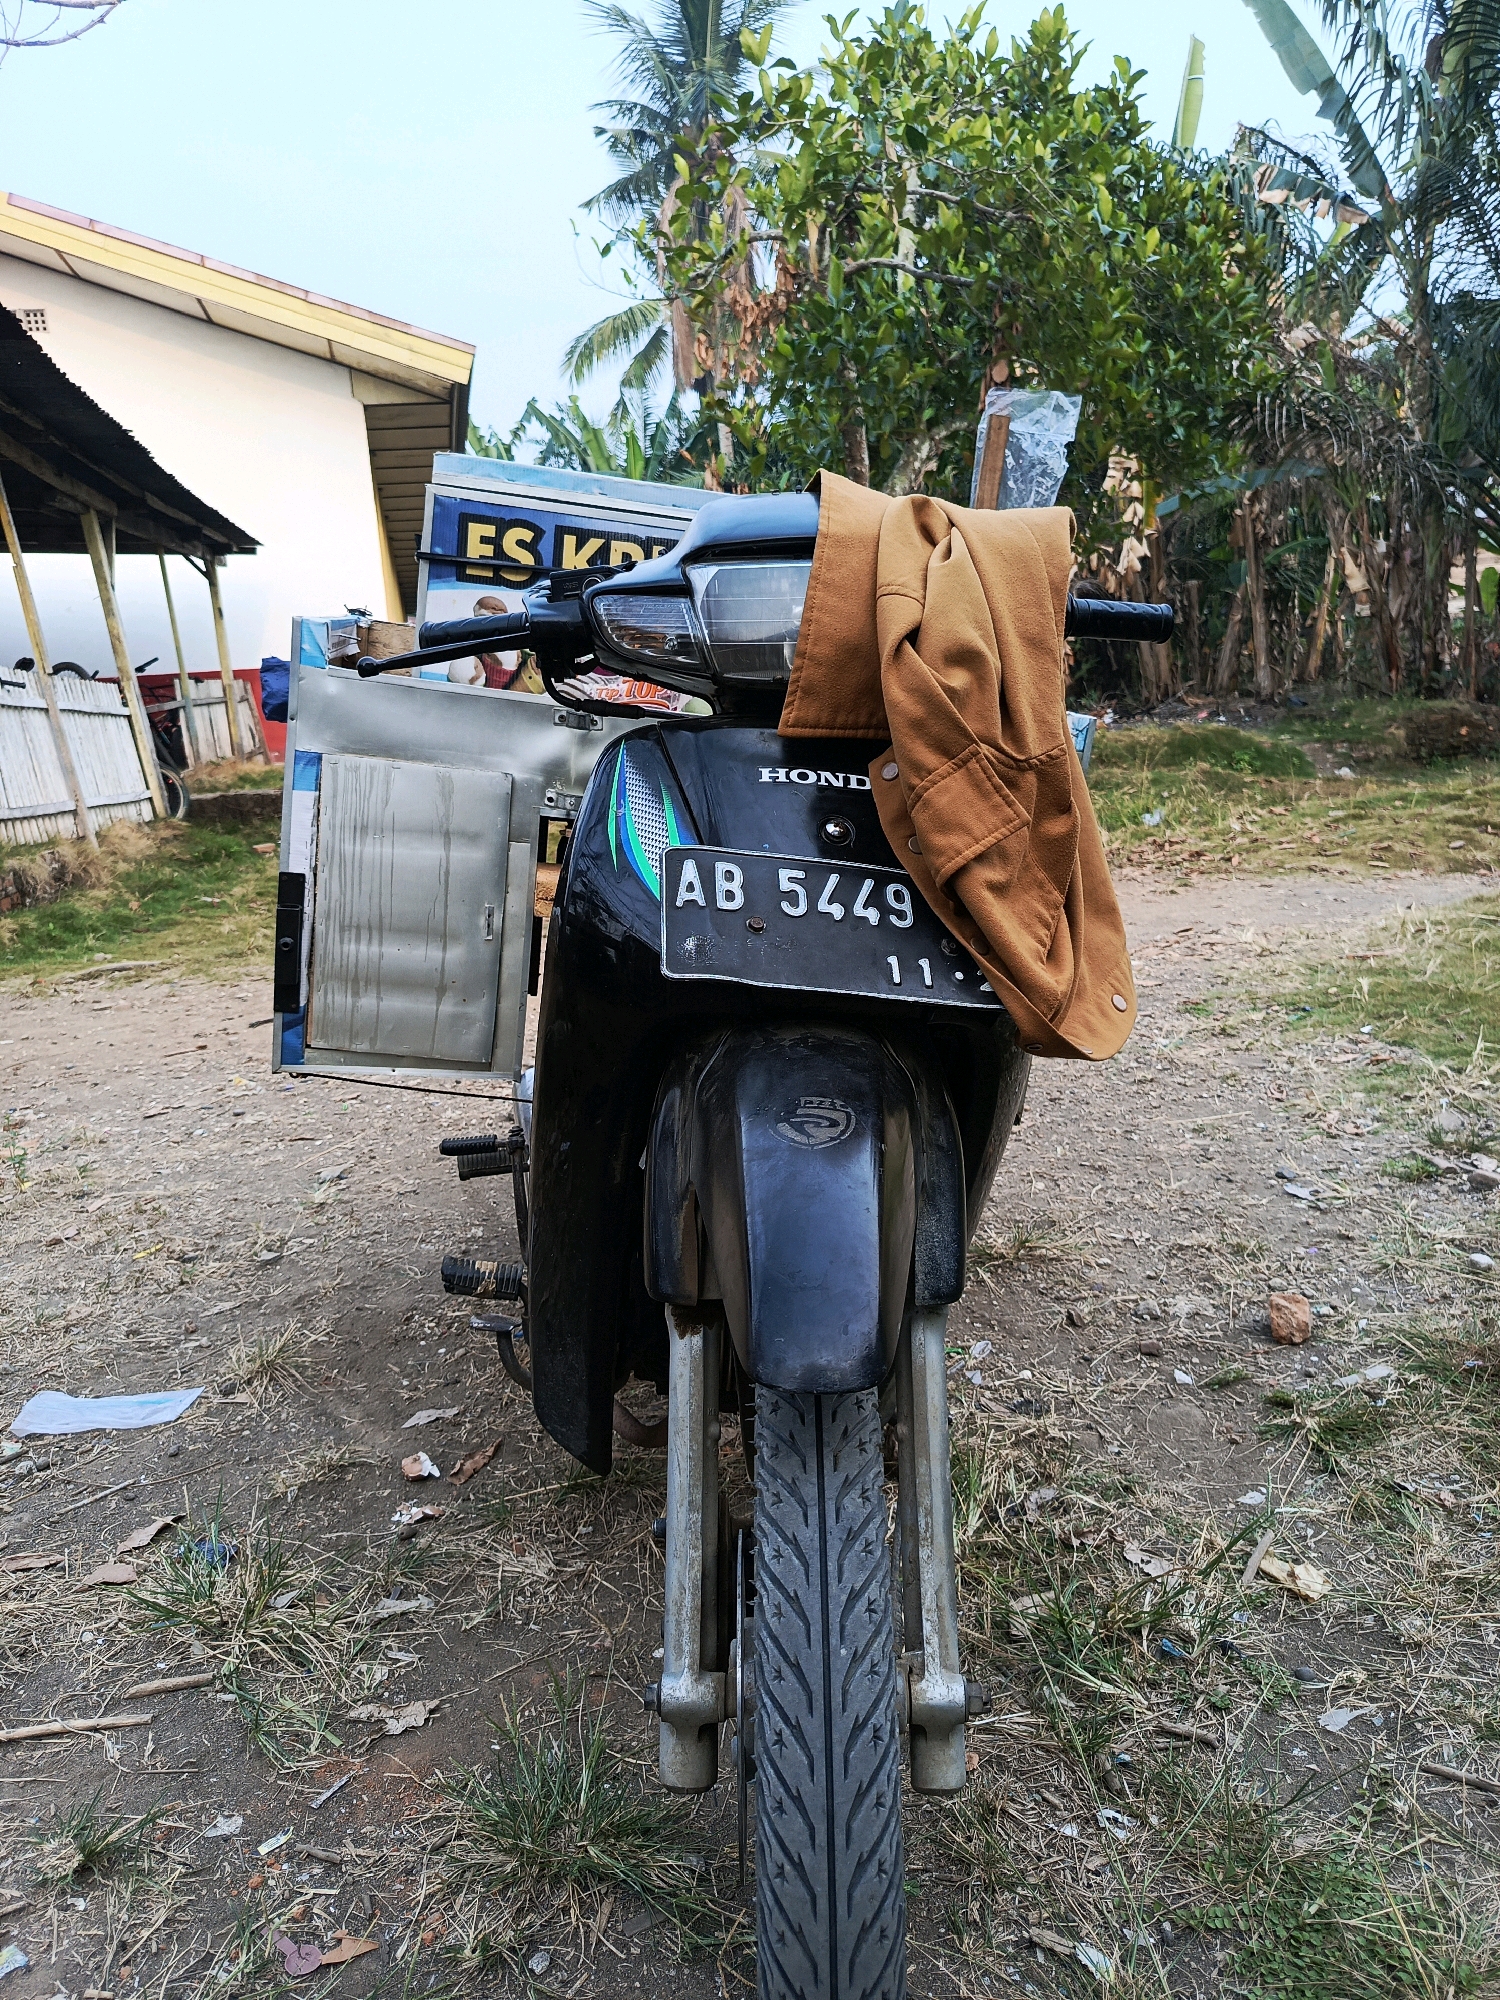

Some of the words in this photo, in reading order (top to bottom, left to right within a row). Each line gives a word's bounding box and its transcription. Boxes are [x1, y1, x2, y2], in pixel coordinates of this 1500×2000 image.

[466, 522, 535, 582] ES
[596, 688, 620, 701] Tip
[676, 858, 745, 910] AB
[778, 867, 914, 928] 5449
